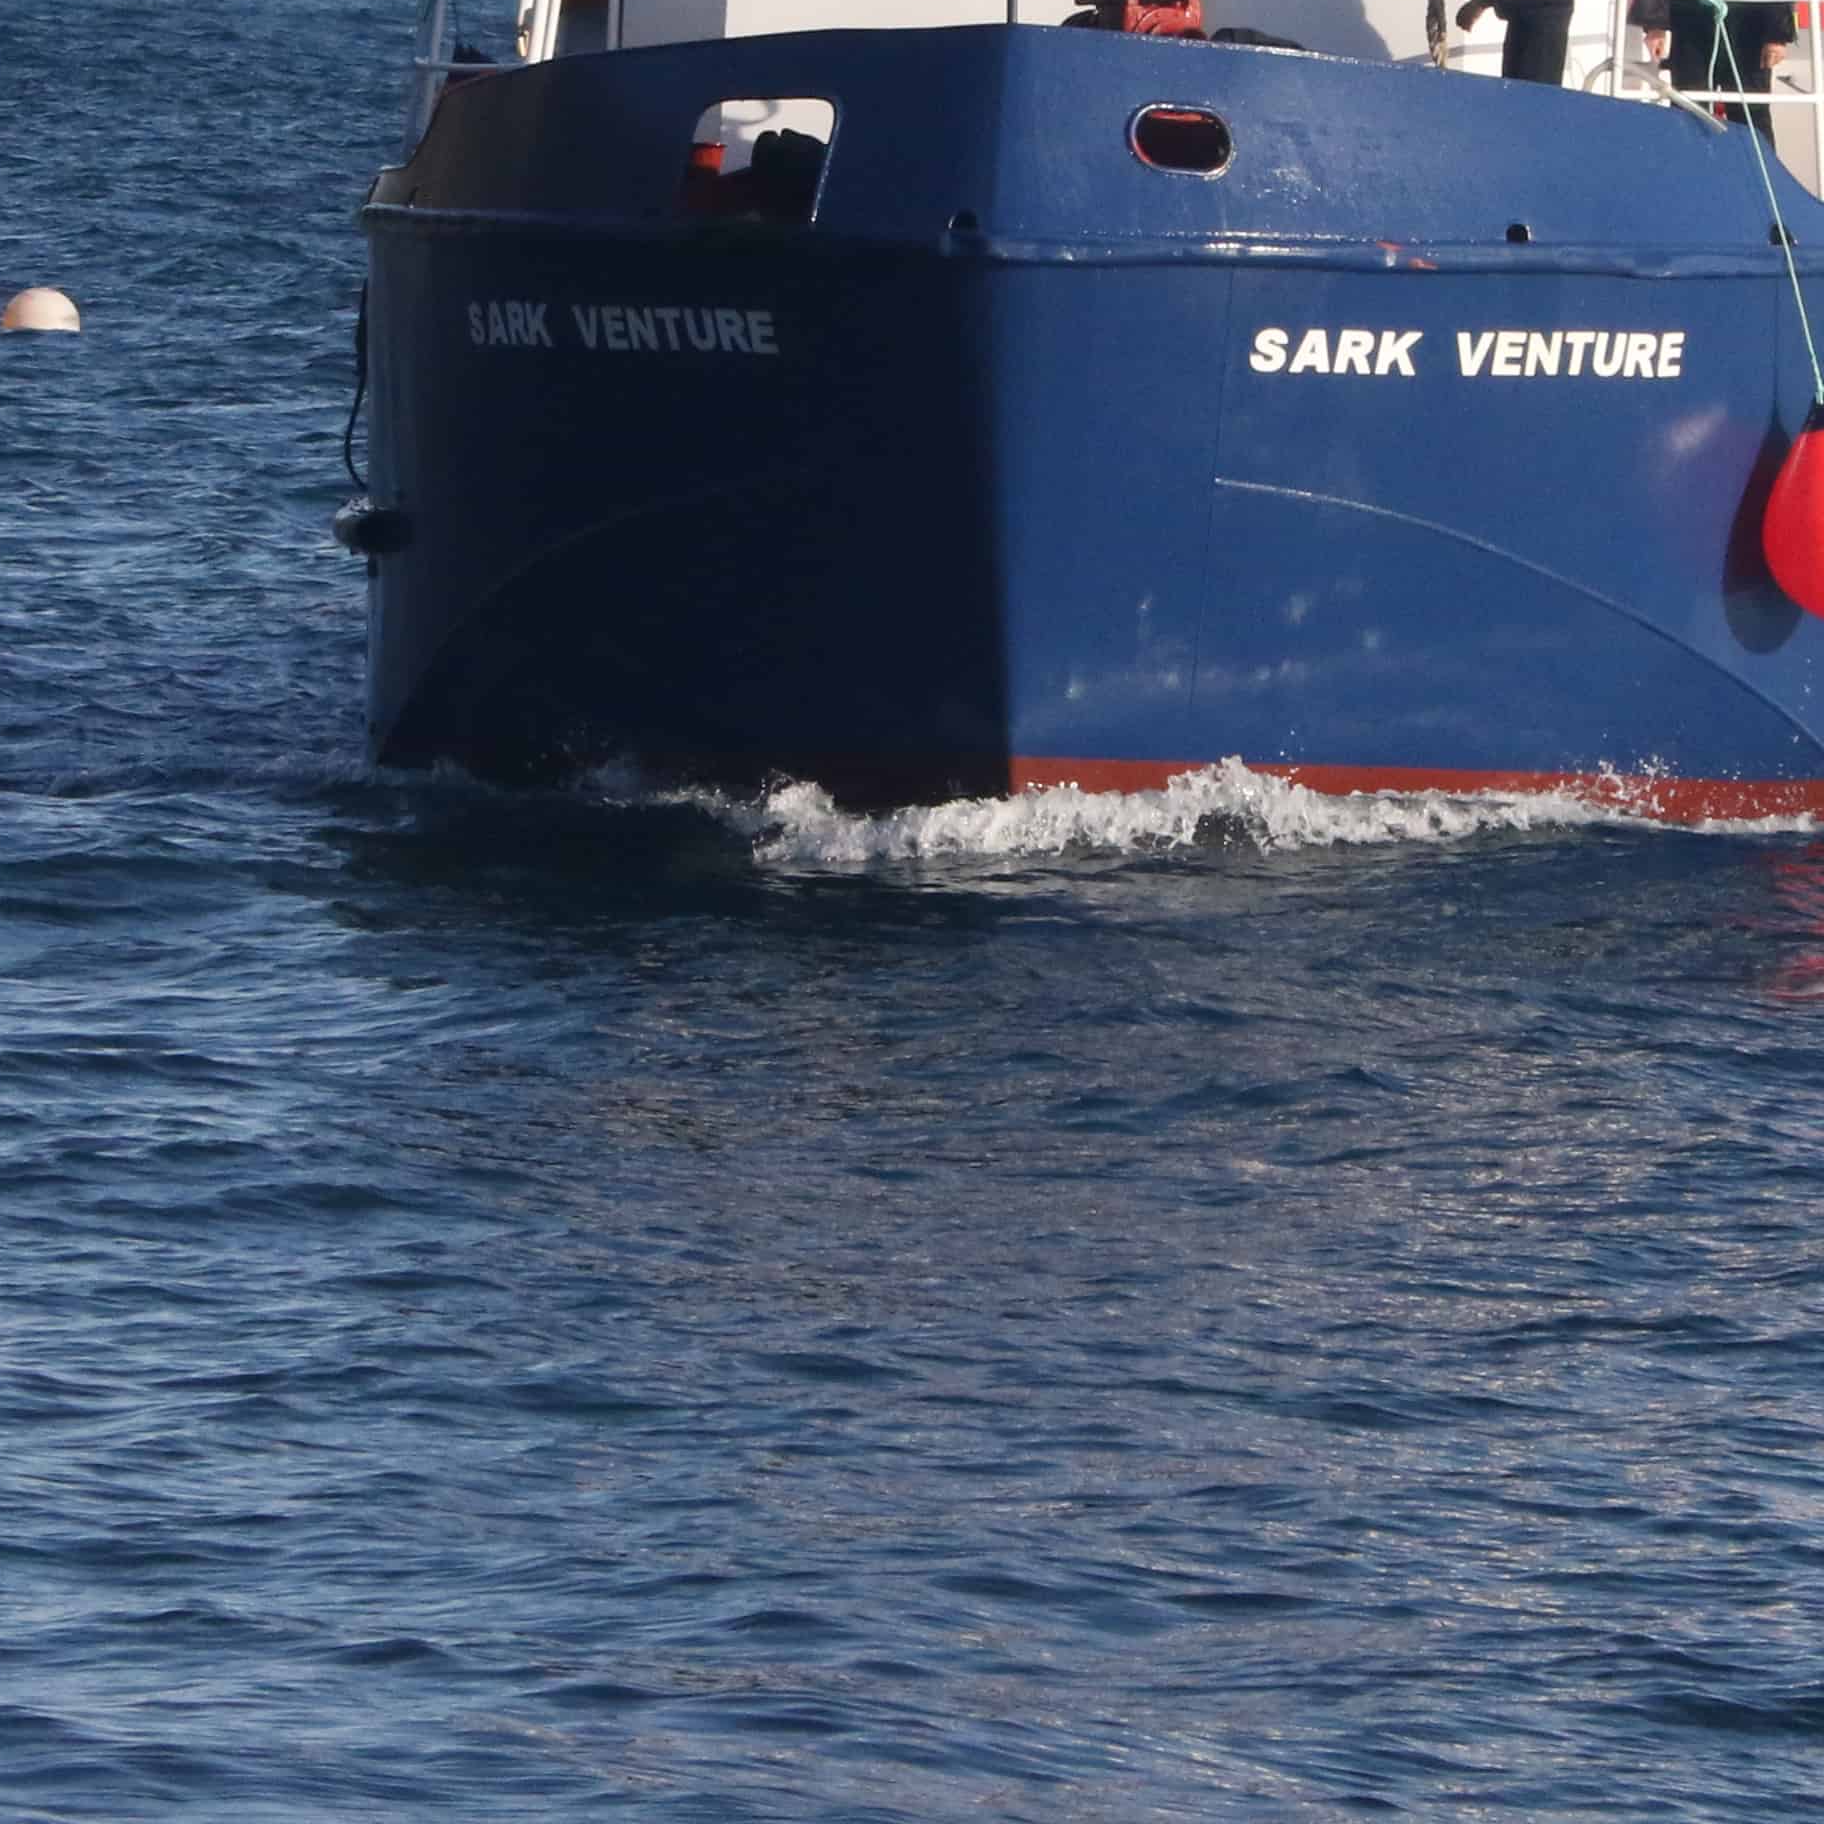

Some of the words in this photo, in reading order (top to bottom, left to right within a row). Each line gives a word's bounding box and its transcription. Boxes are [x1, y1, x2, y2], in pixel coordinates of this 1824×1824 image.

[467, 300, 554, 347] SARK
[571, 304, 778, 354] VENTURE
[1249, 328, 1423, 376] SARK
[1456, 331, 1685, 378] VENTURE
